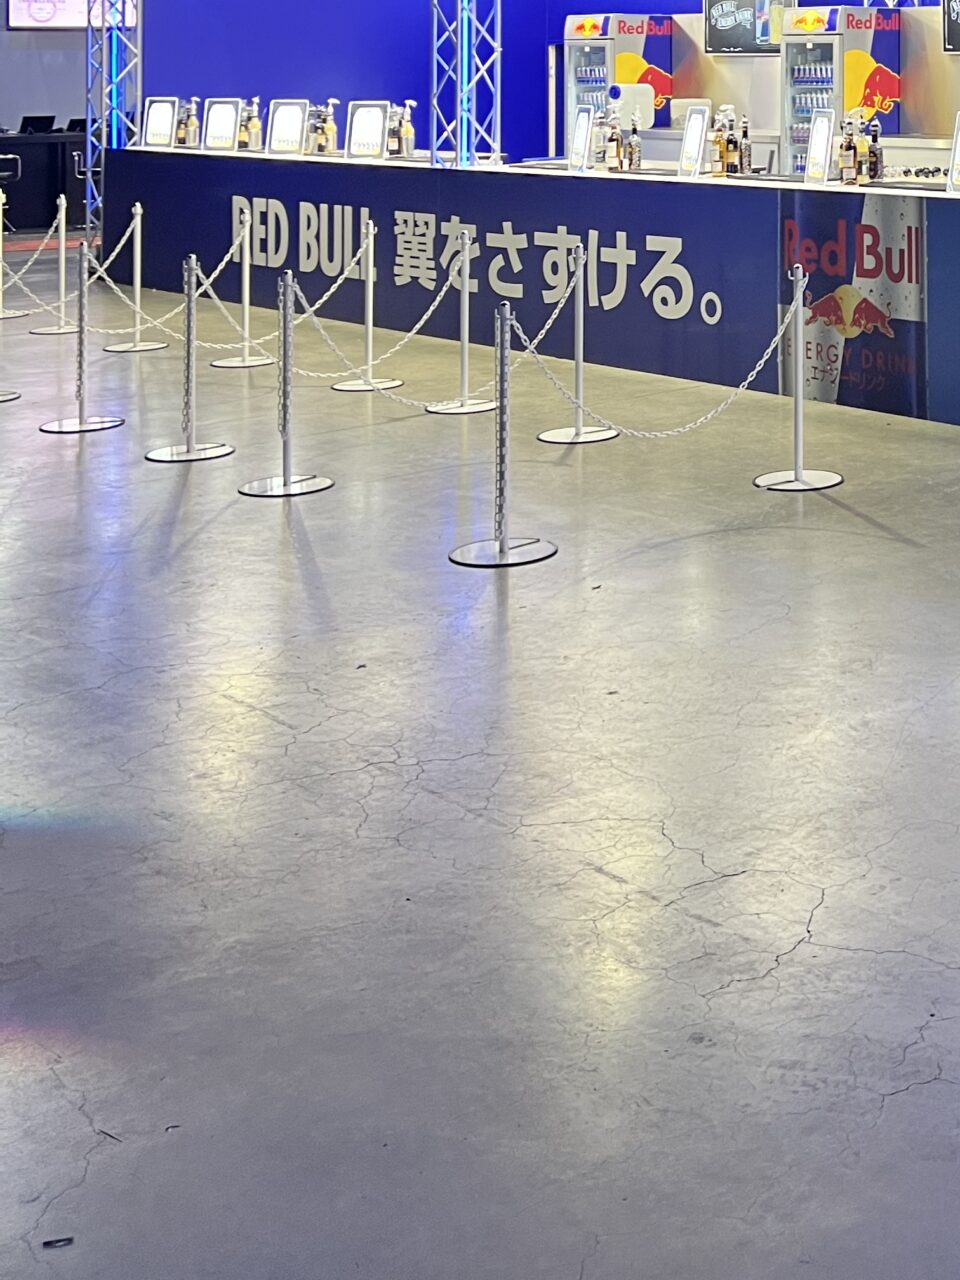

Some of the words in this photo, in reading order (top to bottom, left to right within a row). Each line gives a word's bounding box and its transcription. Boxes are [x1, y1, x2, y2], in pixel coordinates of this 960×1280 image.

[617, 20, 644, 35] Red
[647, 20, 672, 35] Bull
[846, 12, 872, 30] Red
[875, 13, 900, 31] Bull
[231, 195, 290, 269] RED
[298, 201, 377, 282] BULL
[784, 219, 847, 277] Red
[855, 223, 920, 285] Bull
[786, 337, 854, 365] EERGY
